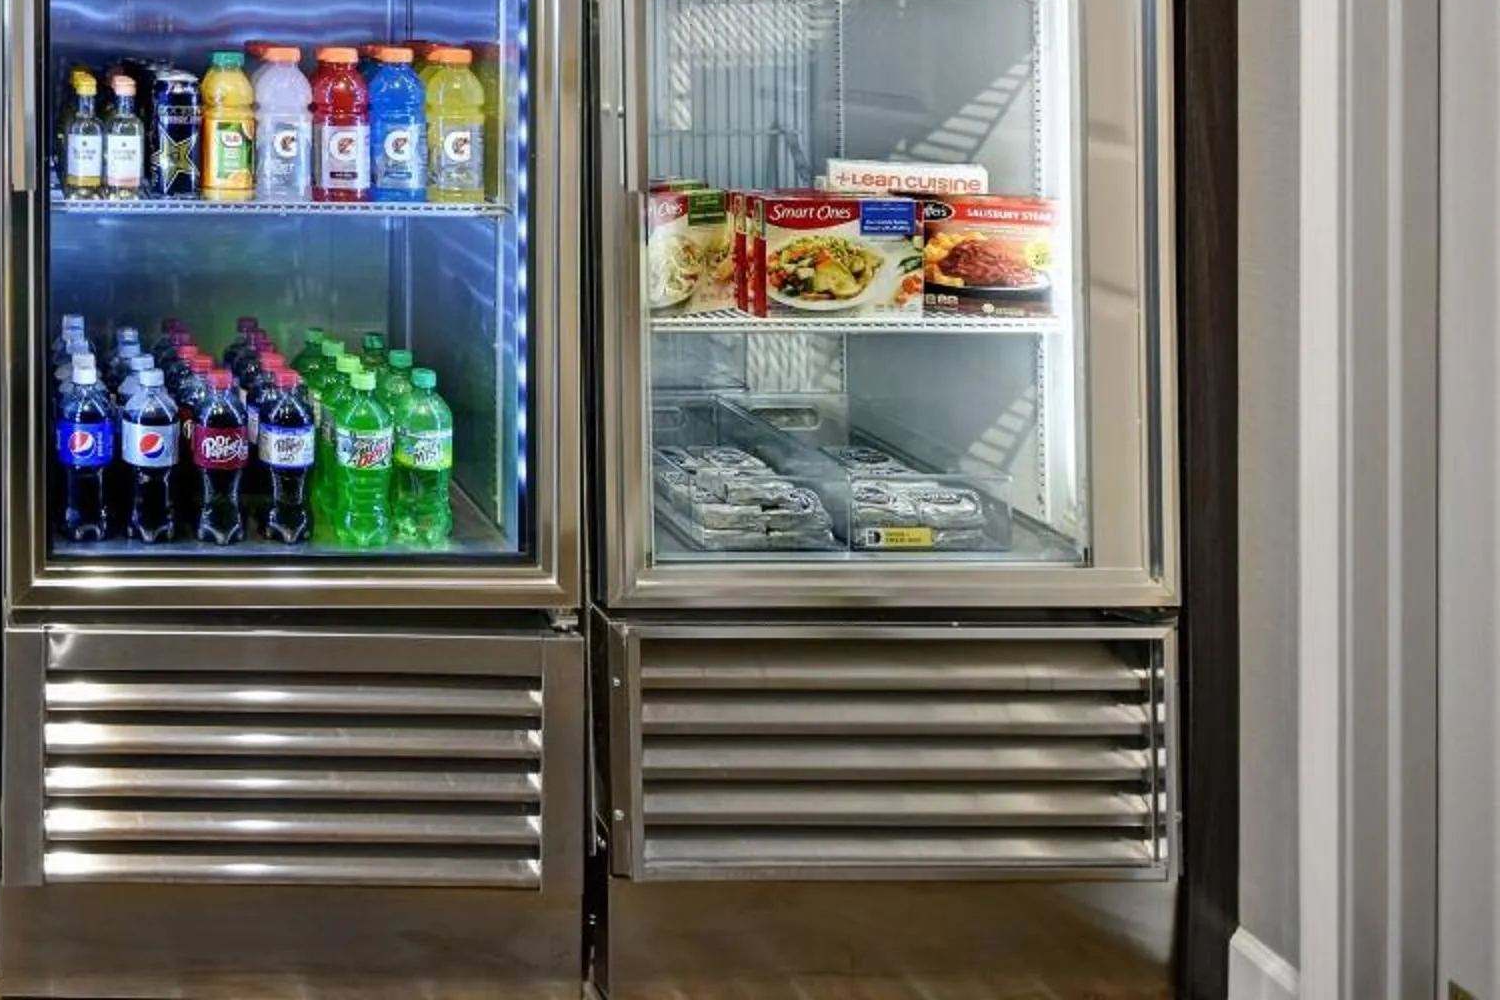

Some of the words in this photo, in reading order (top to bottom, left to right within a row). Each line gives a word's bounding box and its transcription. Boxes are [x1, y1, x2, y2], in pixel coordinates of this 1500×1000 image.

[851, 172, 901, 188] Lean
[769, 202, 815, 221] Smart
[816, 204, 852, 221] Ones
